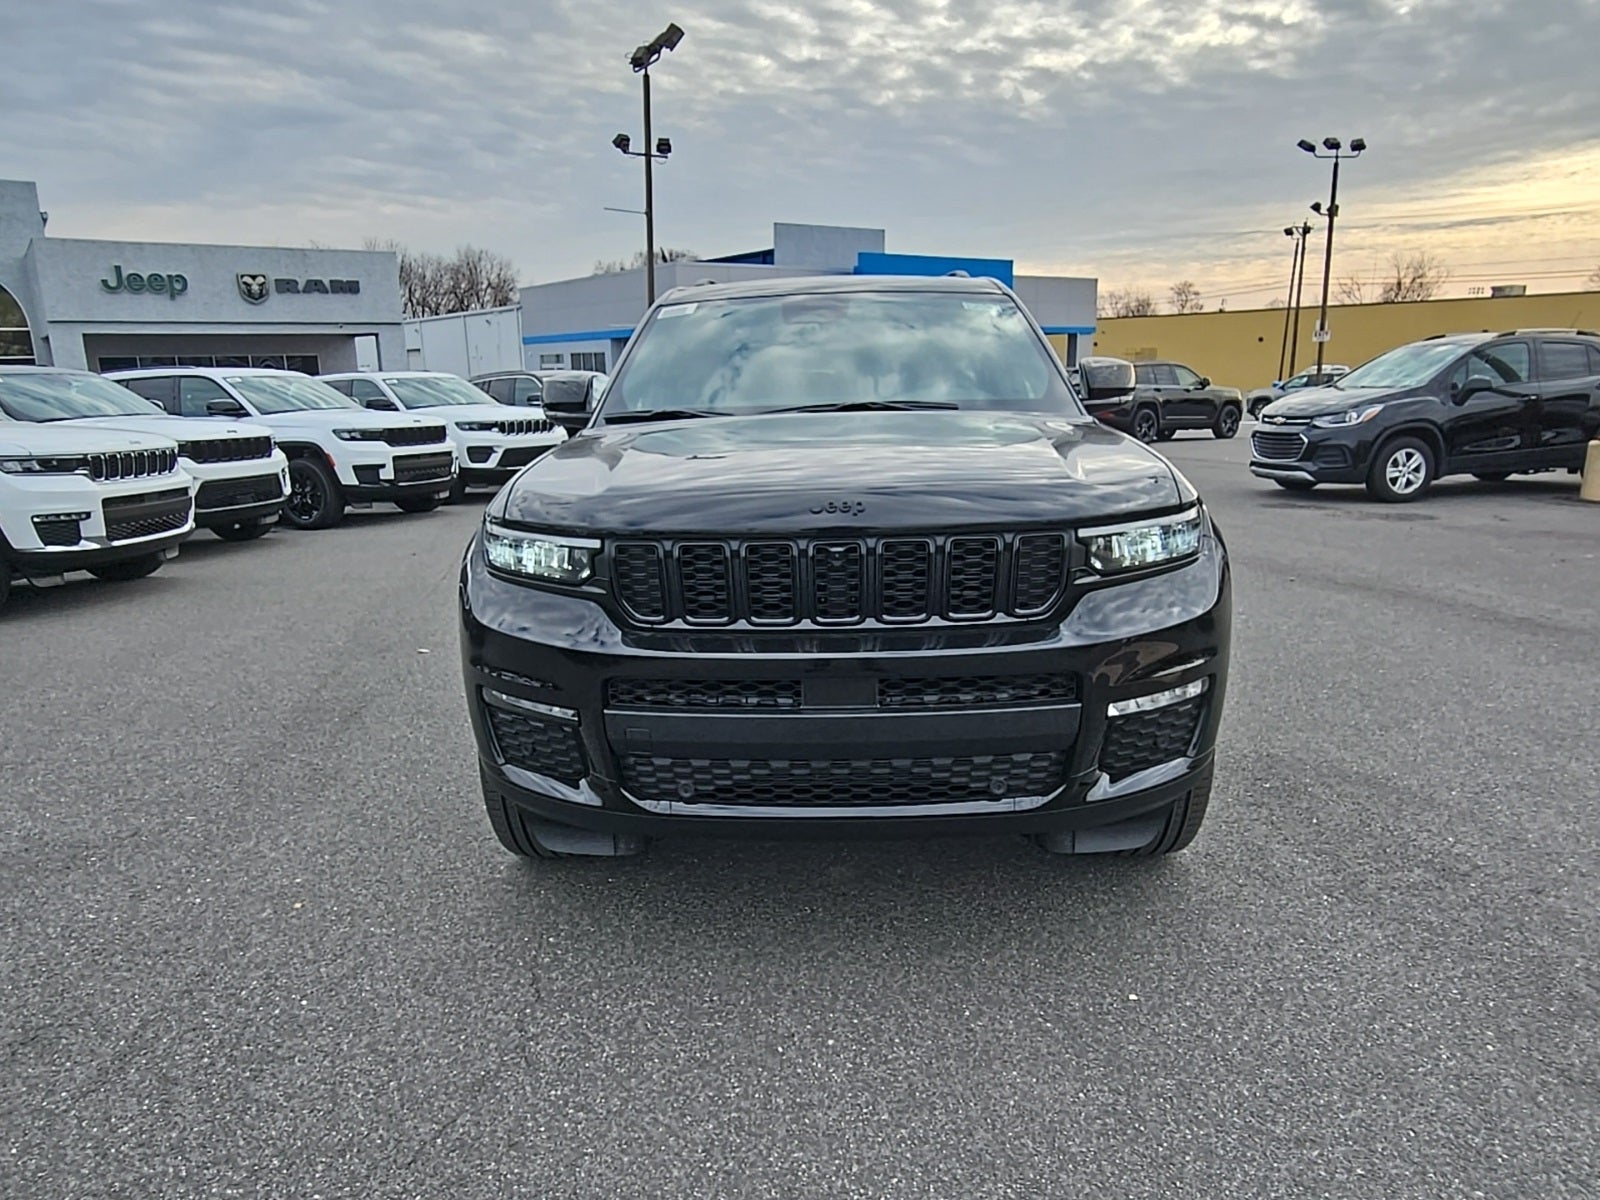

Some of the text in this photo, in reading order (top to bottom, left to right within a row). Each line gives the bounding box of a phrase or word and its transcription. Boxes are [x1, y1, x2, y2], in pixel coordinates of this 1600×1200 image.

[101, 265, 188, 300] Jeep
[275, 278, 360, 295] RAM
[808, 498, 866, 517] Jeep
